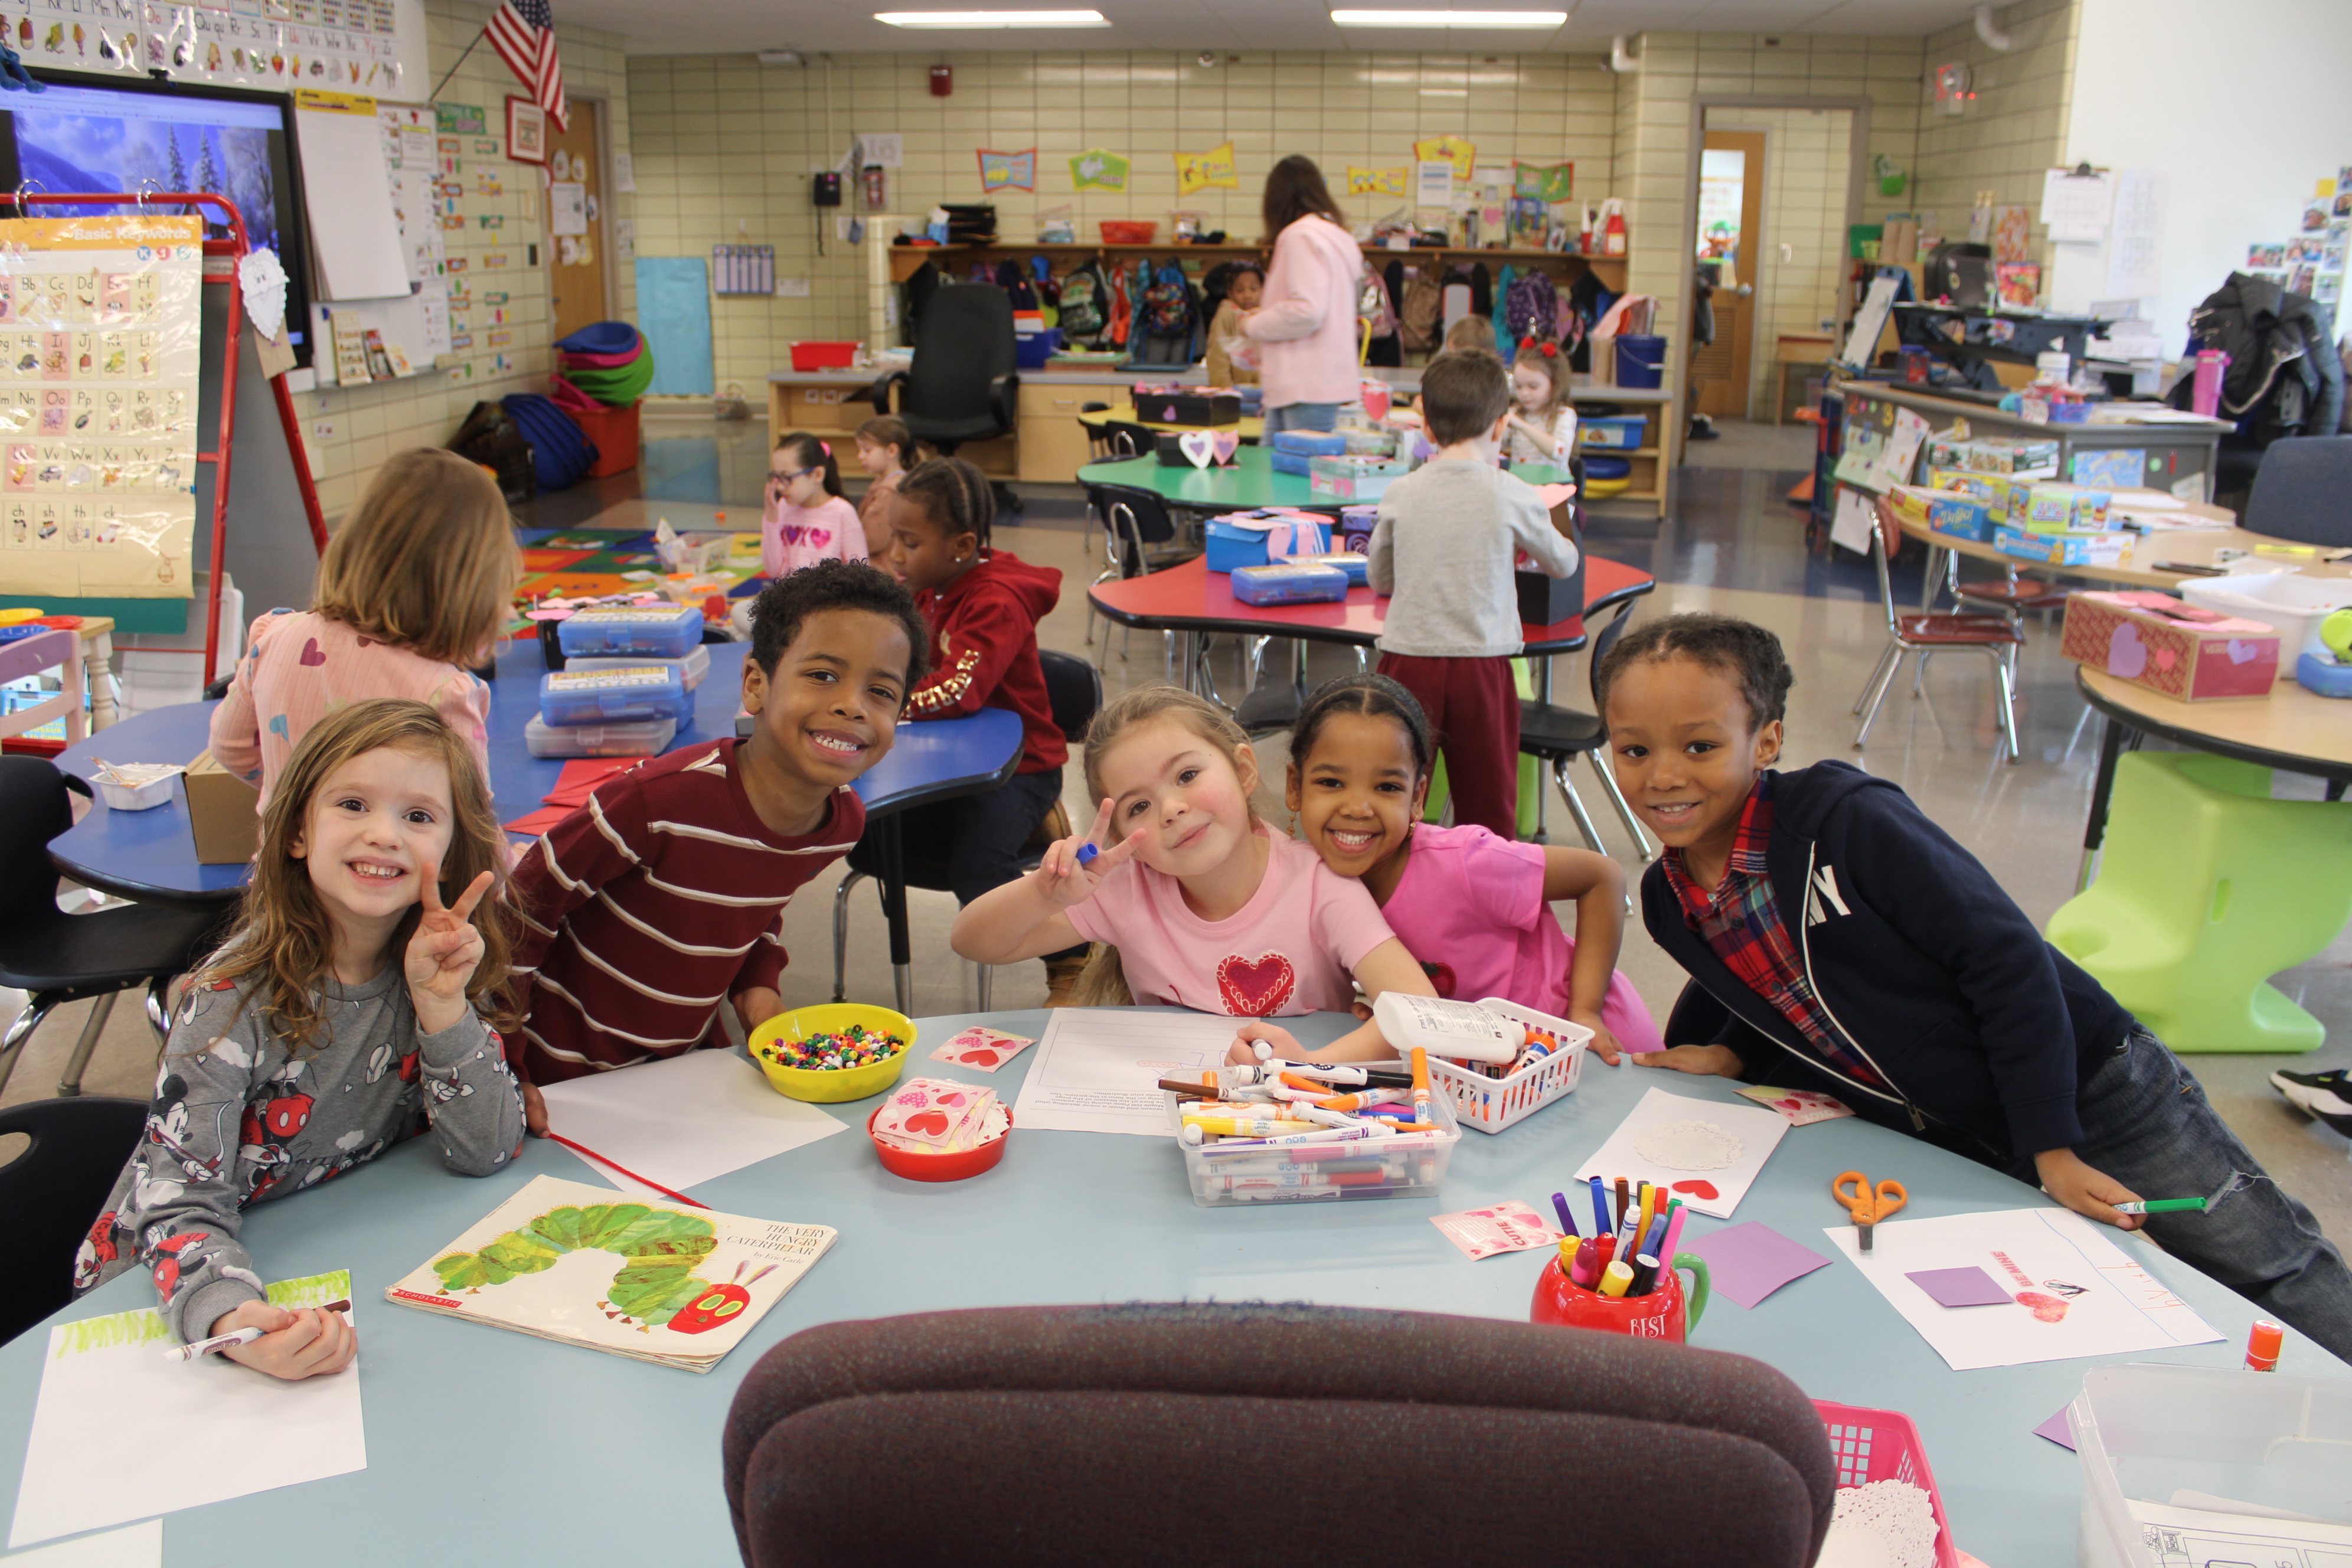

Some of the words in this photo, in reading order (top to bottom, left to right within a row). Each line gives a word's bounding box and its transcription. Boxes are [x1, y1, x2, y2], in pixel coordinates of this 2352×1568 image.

[73, 228, 112, 241] Basic
[116, 227, 192, 242] Keywords
[22, 277, 35, 290] Bb
[50, 276, 64, 290] Cc
[78, 276, 93, 290] Dd
[138, 276, 152, 289] Ff
[22, 334, 36, 348] Hh
[51, 334, 62, 348] Ii
[79, 334, 91, 352] Jj
[107, 334, 121, 348] Kk
[141, 334, 150, 348] Ll
[19, 392, 35, 405] Nn
[47, 392, 65, 405] Oo
[79, 392, 92, 407] Pp
[107, 392, 122, 404] Qu
[138, 392, 150, 405] Rr
[44, 447, 60, 460] Vv
[71, 448, 92, 460] Ww
[104, 448, 118, 460] Xx
[135, 448, 149, 462] Yy
[13, 504, 25, 517] ch
[43, 505, 54, 517] sh
[74, 505, 86, 517] th
[104, 505, 116, 518] ck
[1801, 1109, 1835, 1122] XOXO
[766, 1224, 793, 1234] THE
[795, 1228, 829, 1238] VERY
[1496, 1222, 1527, 1246] CUTIE
[727, 1235, 814, 1256] CATERPILLAR
[766, 1233, 822, 1247] HUNGRY
[1993, 1252, 2021, 1273] MINE
[2015, 1275, 2034, 1287] BE
[398, 1291, 460, 1306] SCHOLASTIC
[1630, 1314, 1666, 1338] BEST
[207, 1340, 240, 1355] Crayola
